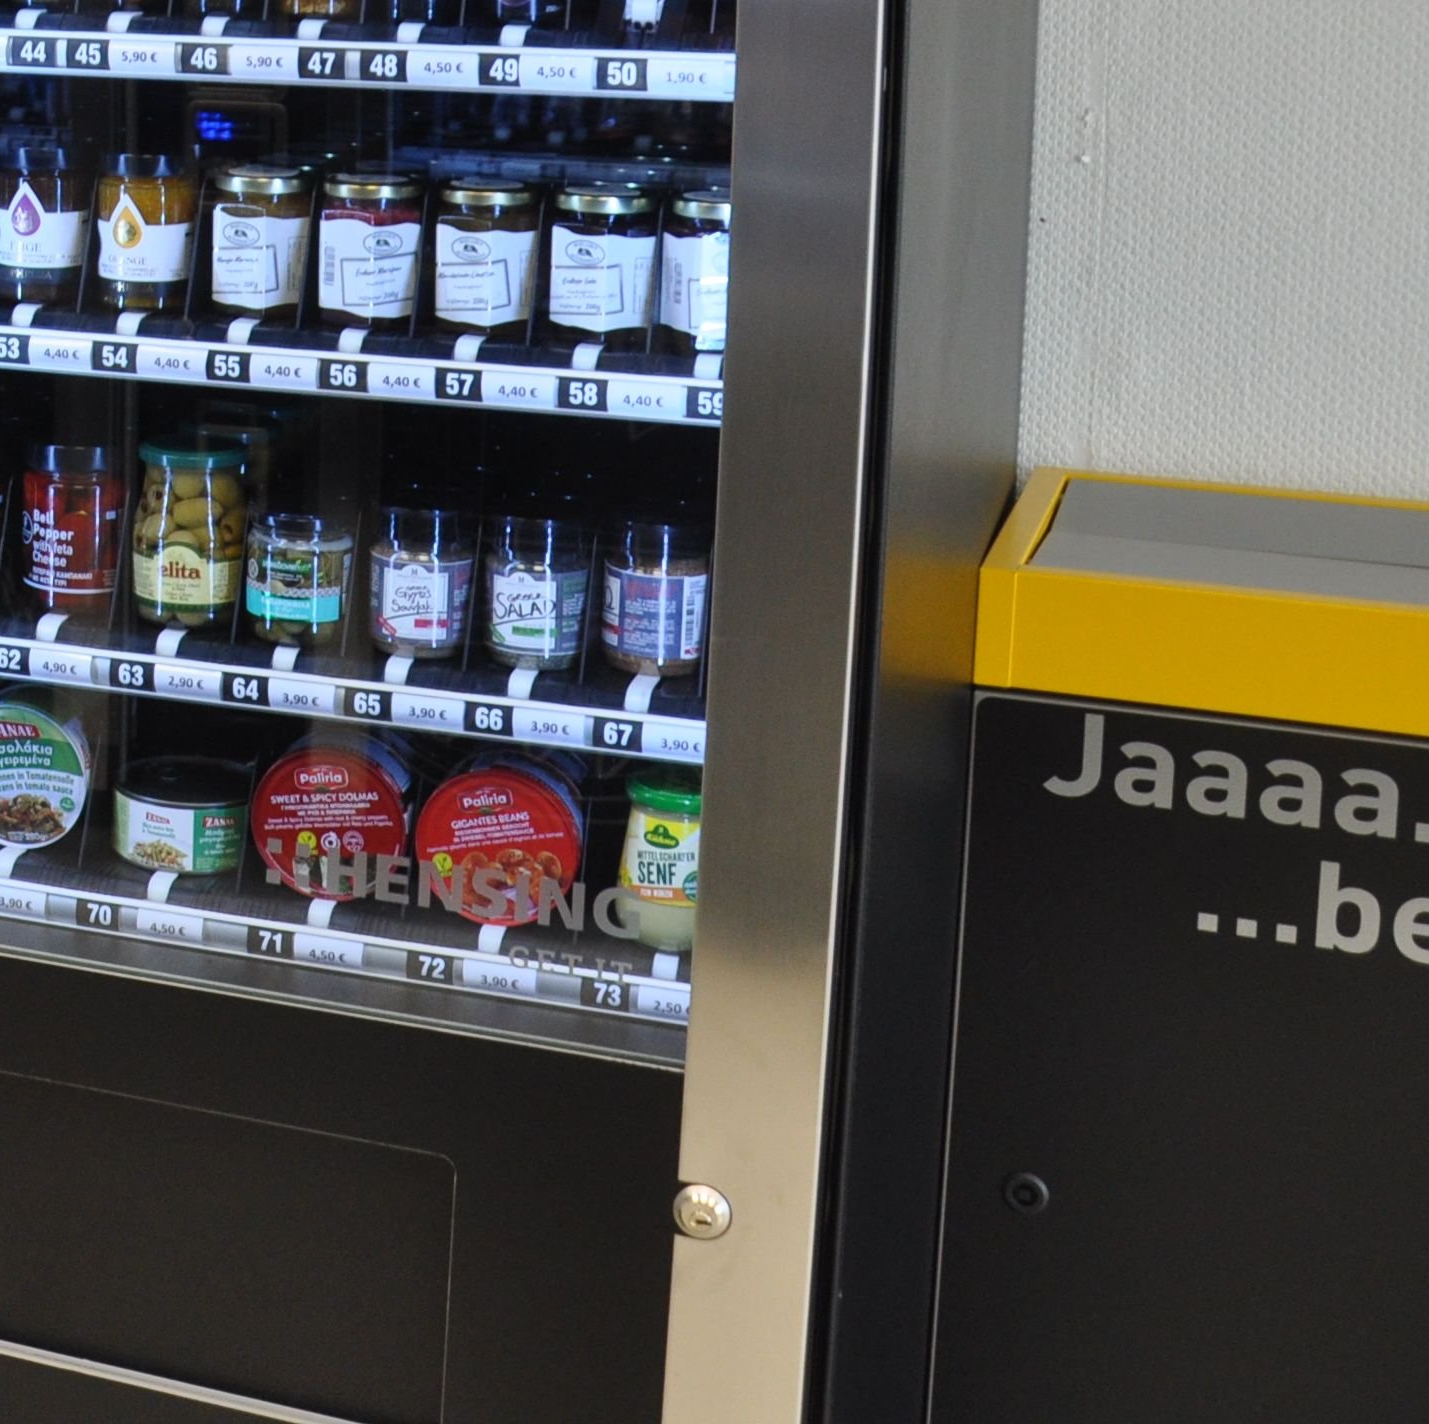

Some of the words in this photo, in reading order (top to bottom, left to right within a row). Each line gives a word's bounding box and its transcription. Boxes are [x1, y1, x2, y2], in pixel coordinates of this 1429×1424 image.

[20, 40, 46, 63] 44
[74, 42, 101, 65] 45
[121, 50, 147, 64] 5,90
[307, 51, 335, 75] 47
[369, 53, 397, 78] 48
[606, 62, 637, 86] 50
[43, 347, 69, 361] 4,40
[214, 354, 240, 377] 55
[445, 372, 474, 396] 57
[498, 384, 526, 399] 4,40
[33, 509, 54, 525] Bell
[34, 524, 74, 542] Pepper
[53, 542, 74, 556] feta
[494, 592, 556, 620] SALAD
[118, 662, 144, 686] 63
[353, 691, 381, 716] 65
[408, 704, 436, 719] 3,90
[603, 721, 631, 746] 67
[270, 794, 300, 805] SWEET
[311, 793, 338, 803] SPICY
[463, 793, 507, 809] Paliria
[451, 817, 498, 830] GIGANTES
[499, 811, 530, 823] BEANS
[638, 861, 677, 886] SENF
[329, 847, 642, 939] HENSING
[258, 930, 283, 954] 71
[309, 947, 335, 962] 4,50
[418, 955, 445, 979] 72
[594, 982, 621, 1007] 73
